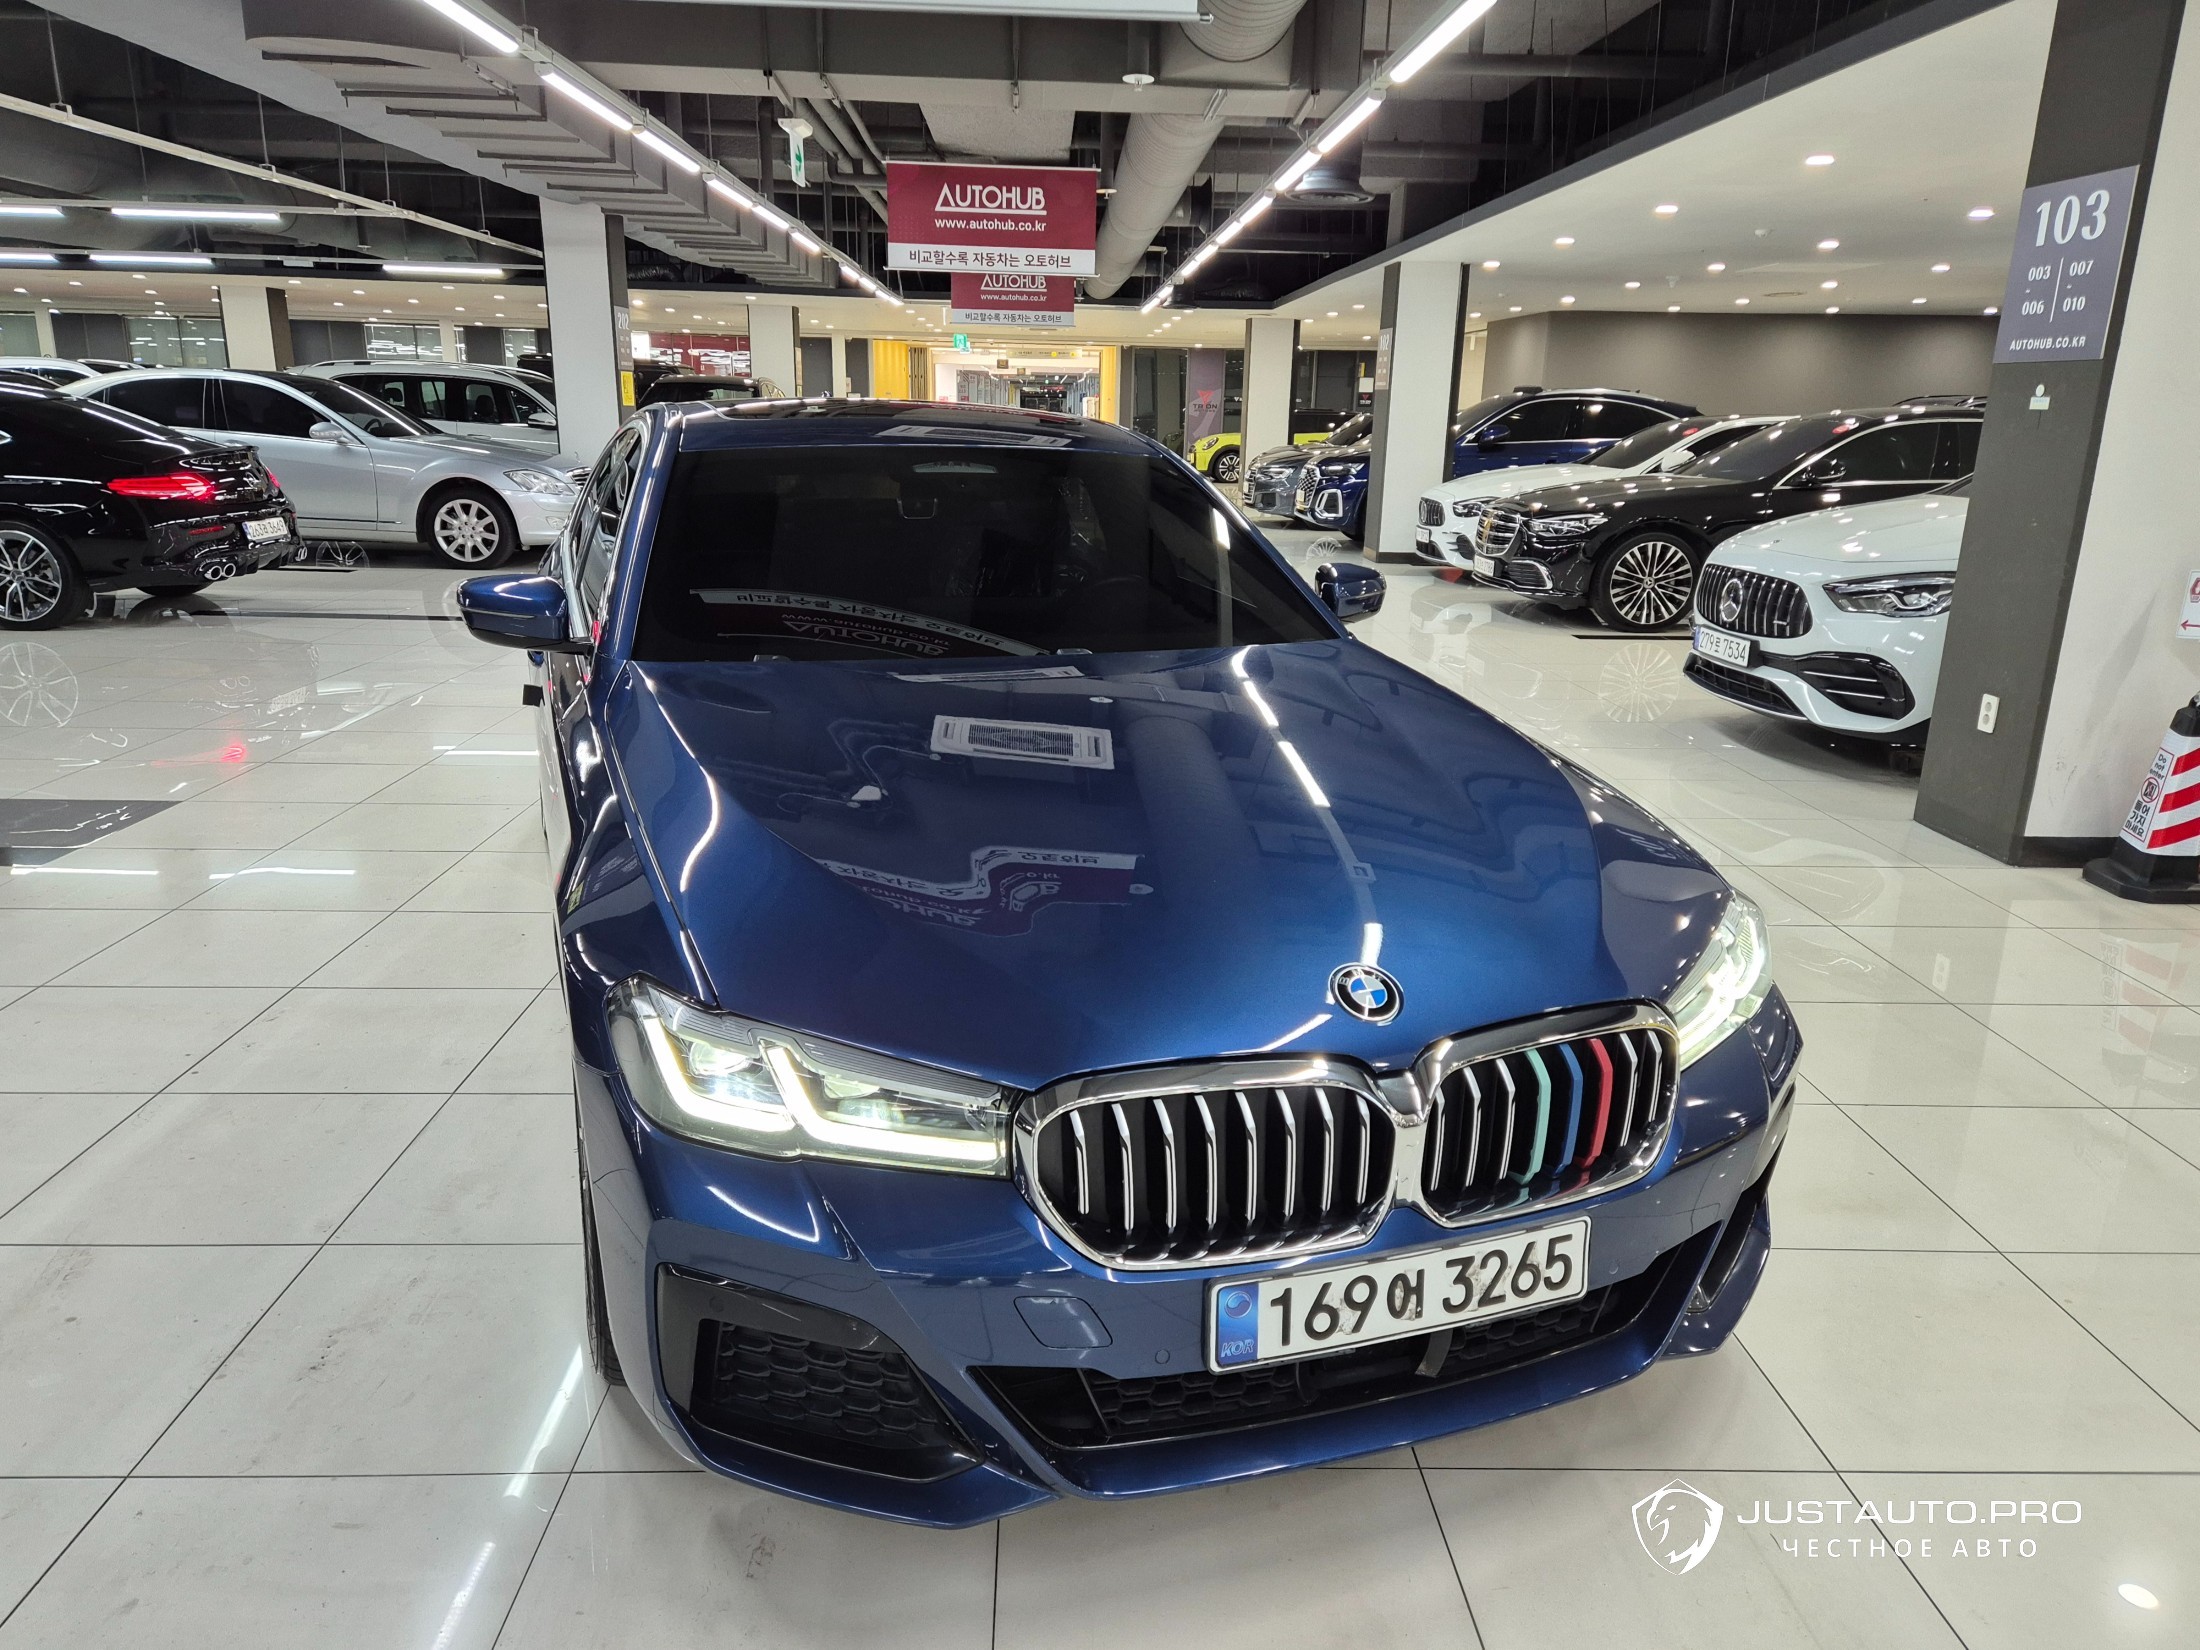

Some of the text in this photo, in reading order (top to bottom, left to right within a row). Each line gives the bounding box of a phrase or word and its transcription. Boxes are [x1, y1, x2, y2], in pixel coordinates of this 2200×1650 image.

[935, 182, 1047, 215] AUTOHUB
[935, 218, 1046, 232] www.autohub.co.kr
[2036, 189, 2110, 247] 103
[909, 250, 1072, 269] 비교할수록 자동차는 오토허브
[2028, 260, 2094, 281] 003 007
[980, 274, 1047, 292] AUTOHUB
[980, 293, 1047, 302] www.autohub.co.kr
[2021, 296, 2086, 315] 006 010
[617, 312, 630, 330] 202
[965, 312, 1062, 323] 비교할수록 자동차는 오토허브
[2009, 336, 2086, 351] AUTOHUB.CO.KR
[1723, 639, 1746, 662] 7534
[2154, 762, 2165, 771] not
[2158, 754, 2167, 764] Do
[2149, 768, 2165, 780] enter
[2130, 811, 2146, 827] 가지
[2125, 820, 2145, 838] 마세요
[1442, 1233, 1574, 1315] 3265
[1220, 1337, 1255, 1358] KOR
